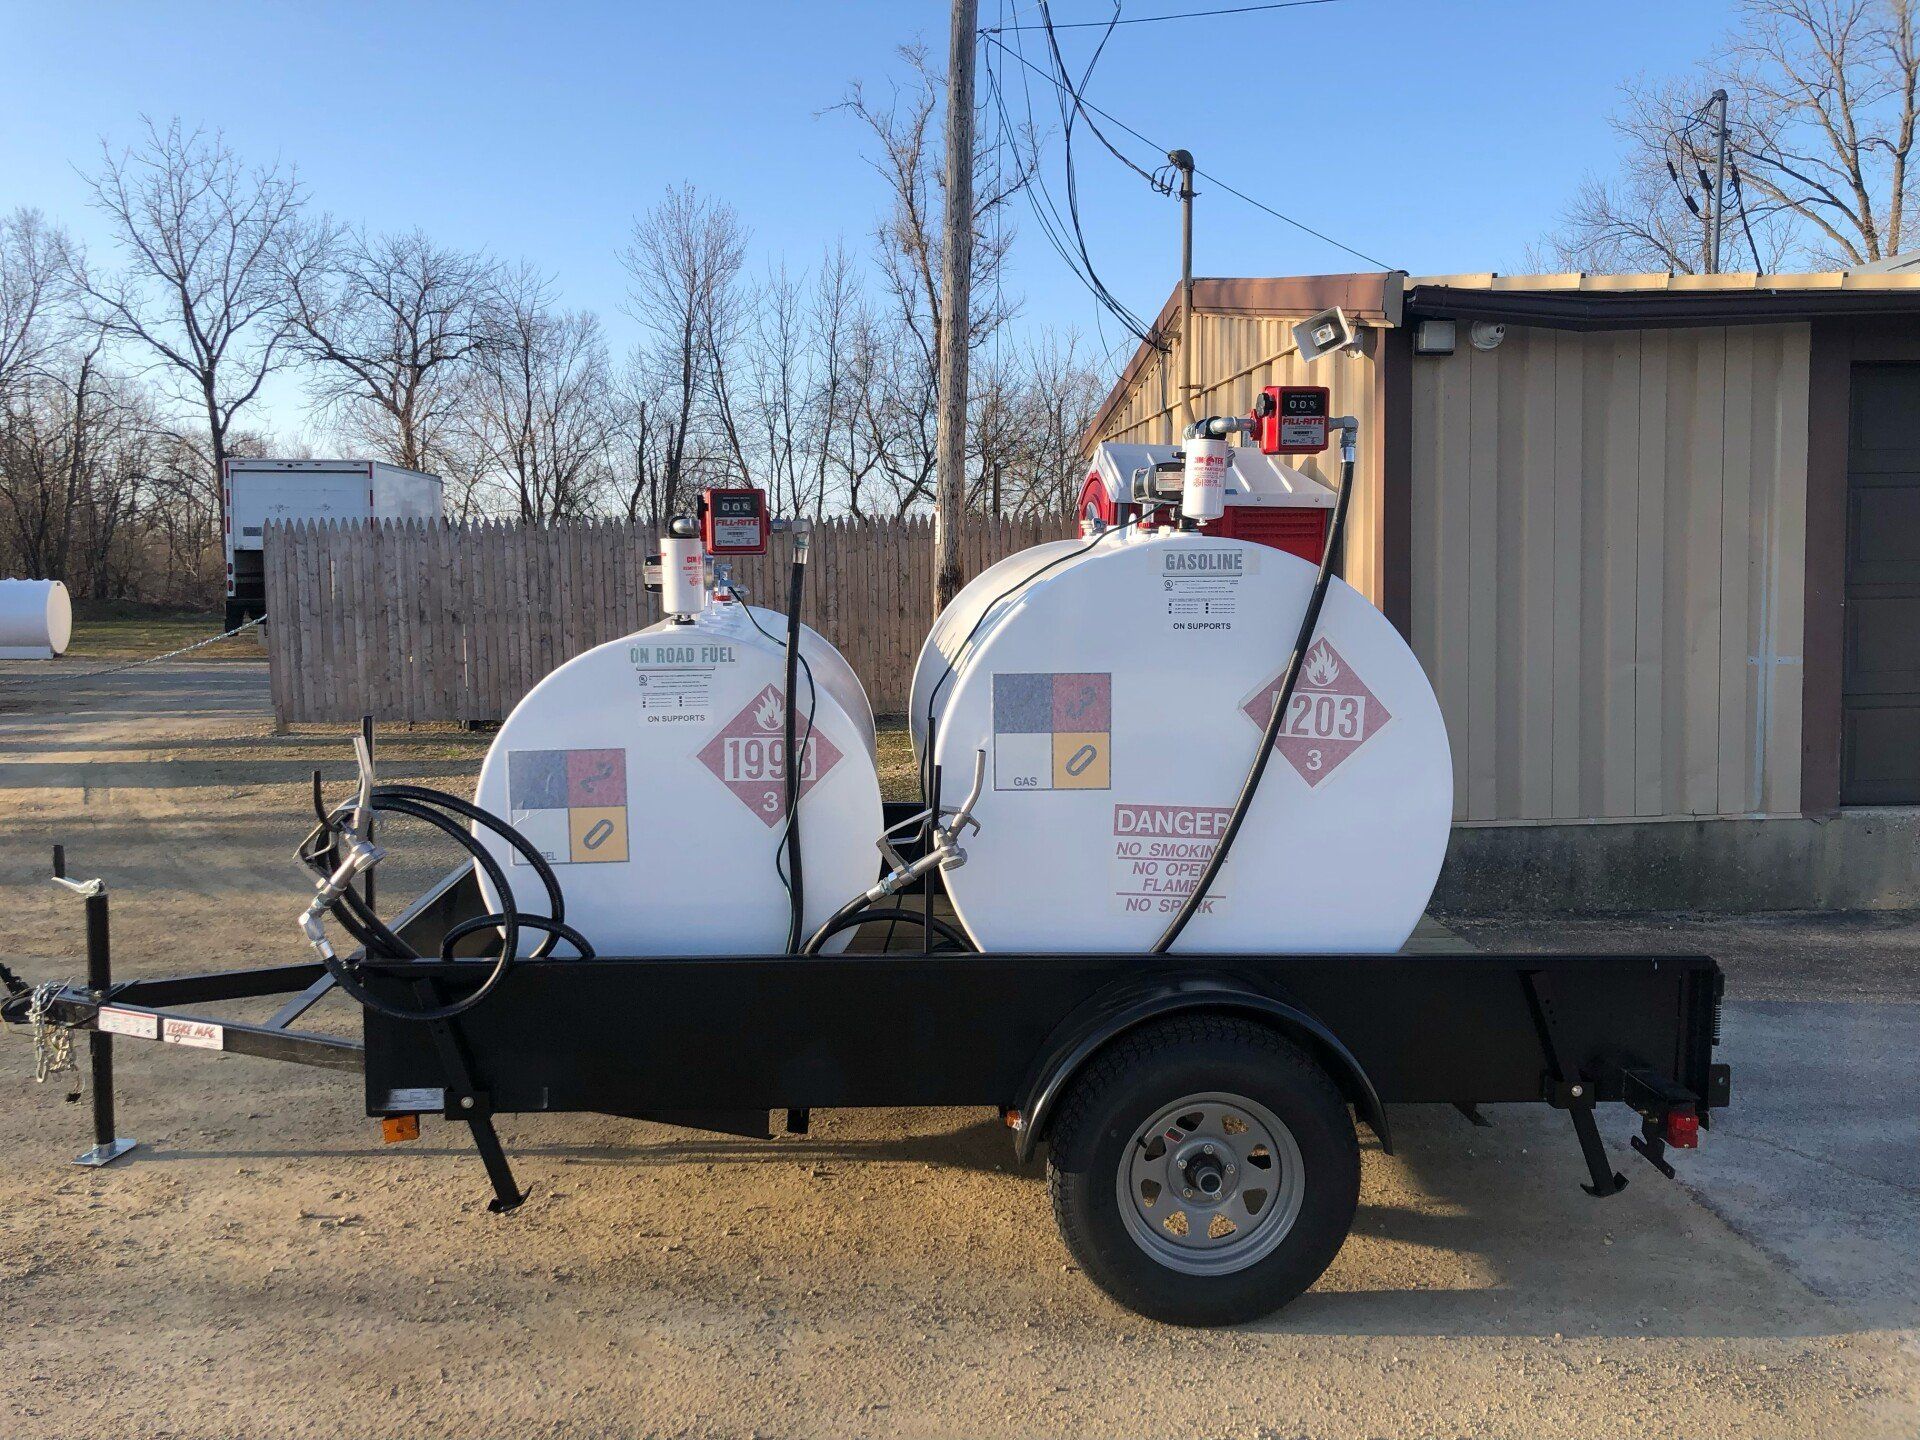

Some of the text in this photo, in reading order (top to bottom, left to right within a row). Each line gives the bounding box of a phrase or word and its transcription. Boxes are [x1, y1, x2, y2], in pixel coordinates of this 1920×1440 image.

[1282, 417, 1324, 426] FILL-RITE
[715, 519, 759, 527] FILL-RITE
[1165, 553, 1243, 570] GASOLINE
[1173, 622, 1231, 630] ON SUPPORTS
[630, 646, 736, 664] ON ROAD FUEL
[647, 714, 706, 723] ON SUPPORTS
[1065, 744, 1098, 777] 0
[1305, 749, 1323, 771] 3
[1013, 776, 1038, 787] GAS
[763, 791, 779, 812] 3
[583, 818, 615, 850] 0
[1116, 841, 1229, 859] NO SMOKIN
[1132, 861, 1159, 876] NO
[1125, 897, 1215, 914] NO SPK
